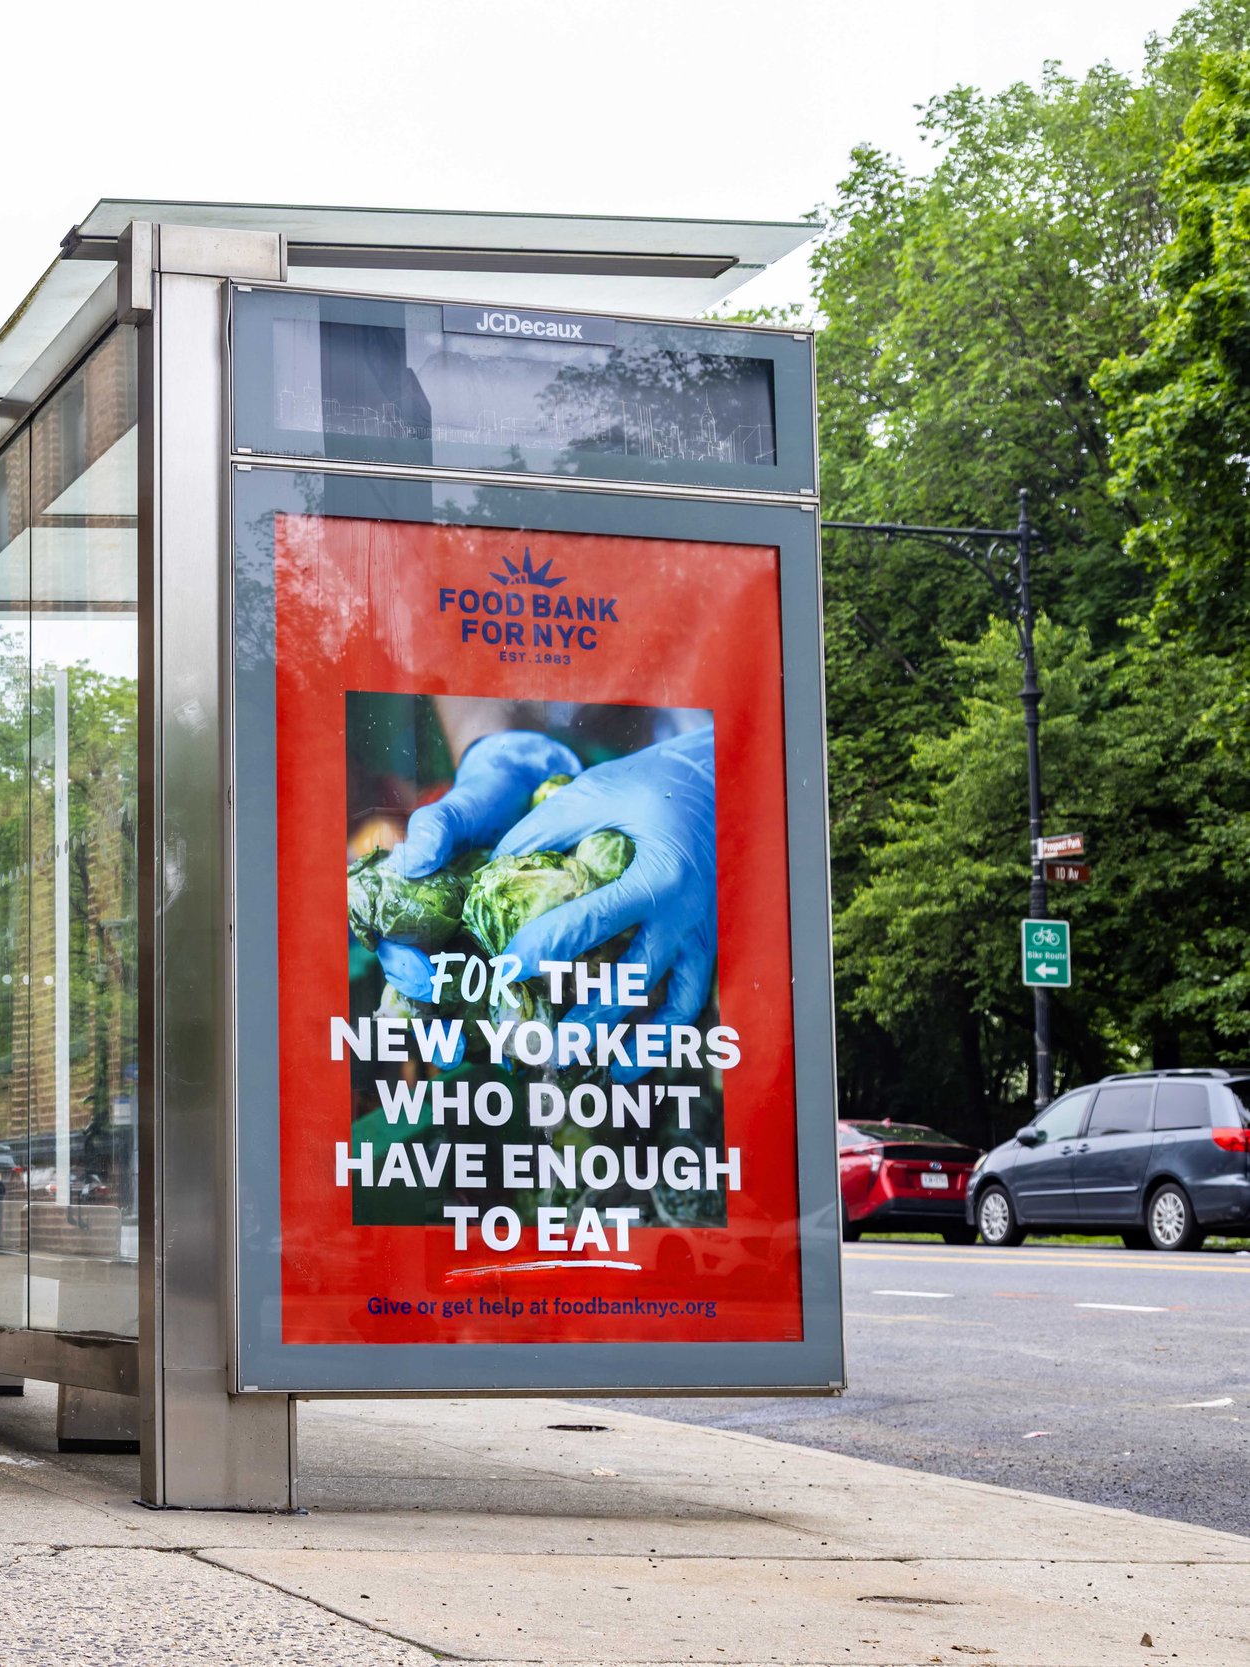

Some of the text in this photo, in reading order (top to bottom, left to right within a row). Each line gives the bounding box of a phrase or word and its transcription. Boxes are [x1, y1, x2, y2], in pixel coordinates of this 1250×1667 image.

[476, 311, 584, 339] JCDecaux
[439, 588, 619, 623] FOOD BANK
[461, 618, 598, 650] FOR NYC
[1067, 837, 1081, 849] Park
[1055, 867, 1079, 880] 10 Av
[1027, 951, 1067, 960] Bike Route
[430, 950, 648, 1009] FOR THE
[330, 1016, 742, 1070] NEW YORKERS
[375, 1079, 701, 1130] WHO DON'T
[335, 1141, 742, 1191] HAVE ENOUGH
[443, 1205, 640, 1252] TO EAT
[367, 1297, 717, 1319] Give or get help at foodbanknyc.org
